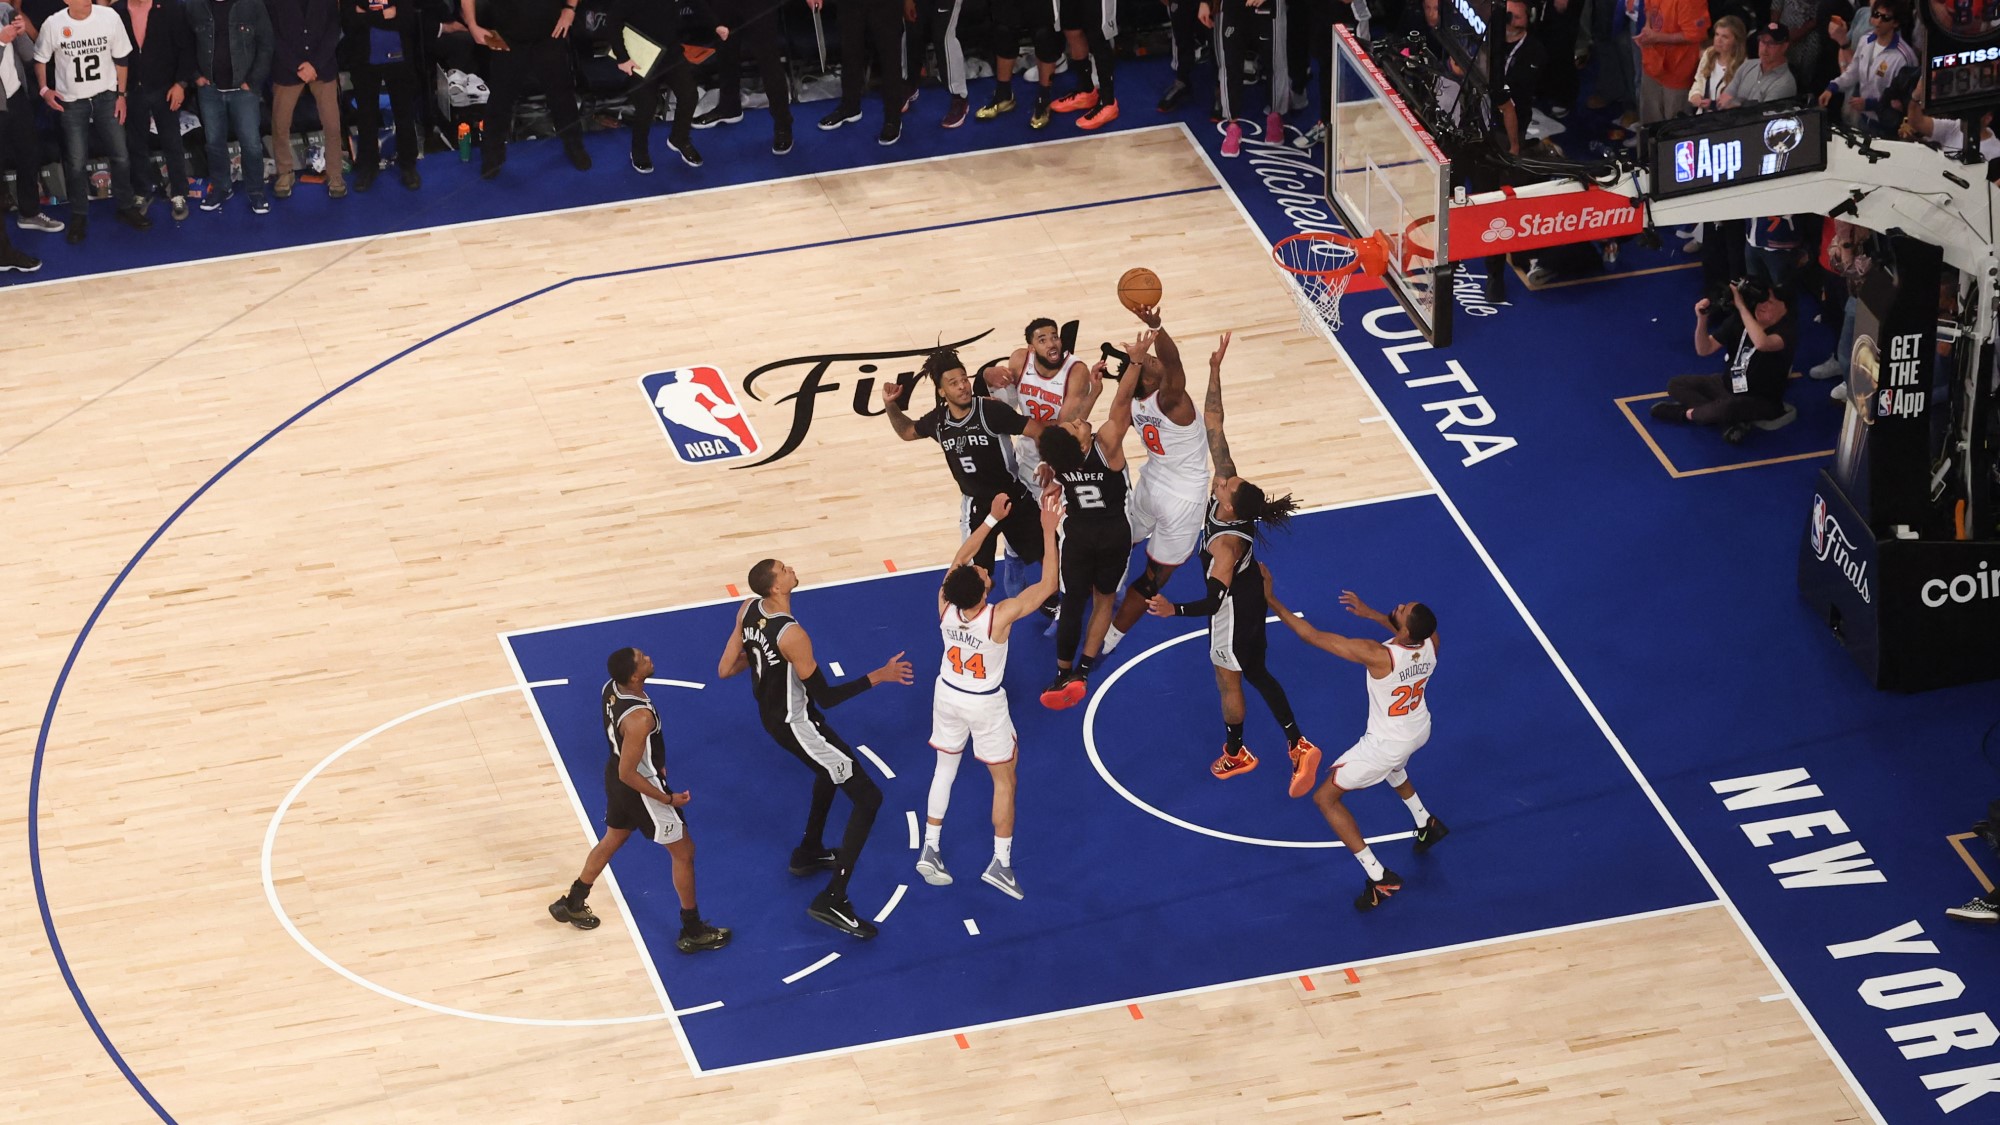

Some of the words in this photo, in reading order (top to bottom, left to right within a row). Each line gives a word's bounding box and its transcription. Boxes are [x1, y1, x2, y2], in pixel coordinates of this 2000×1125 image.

[60, 36, 108, 50] McDONALD'S
[77, 46, 107, 56] AMERICAN
[1958, 47, 2000, 65] TISS
[73, 55, 101, 83] 12
[1697, 138, 1742, 183] App
[1890, 333, 1923, 361] GET
[1361, 305, 1519, 468] ULTRA
[1889, 360, 1921, 386] THE
[1026, 399, 1056, 421] 32
[1892, 388, 1925, 419] App
[684, 439, 730, 459] NBA
[1142, 424, 1165, 456] 8
[959, 456, 978, 474] 5
[1062, 472, 1104, 482] HARPER
[1074, 485, 1106, 509] 2
[1816, 515, 1871, 603] Finals
[947, 628, 983, 650] SHAMET
[947, 645, 986, 679] 44
[1399, 662, 1431, 682] BRIDGES
[1388, 676, 1429, 717] 25
[1709, 767, 1888, 889] NEW
[1825, 919, 2000, 1114] YORK
